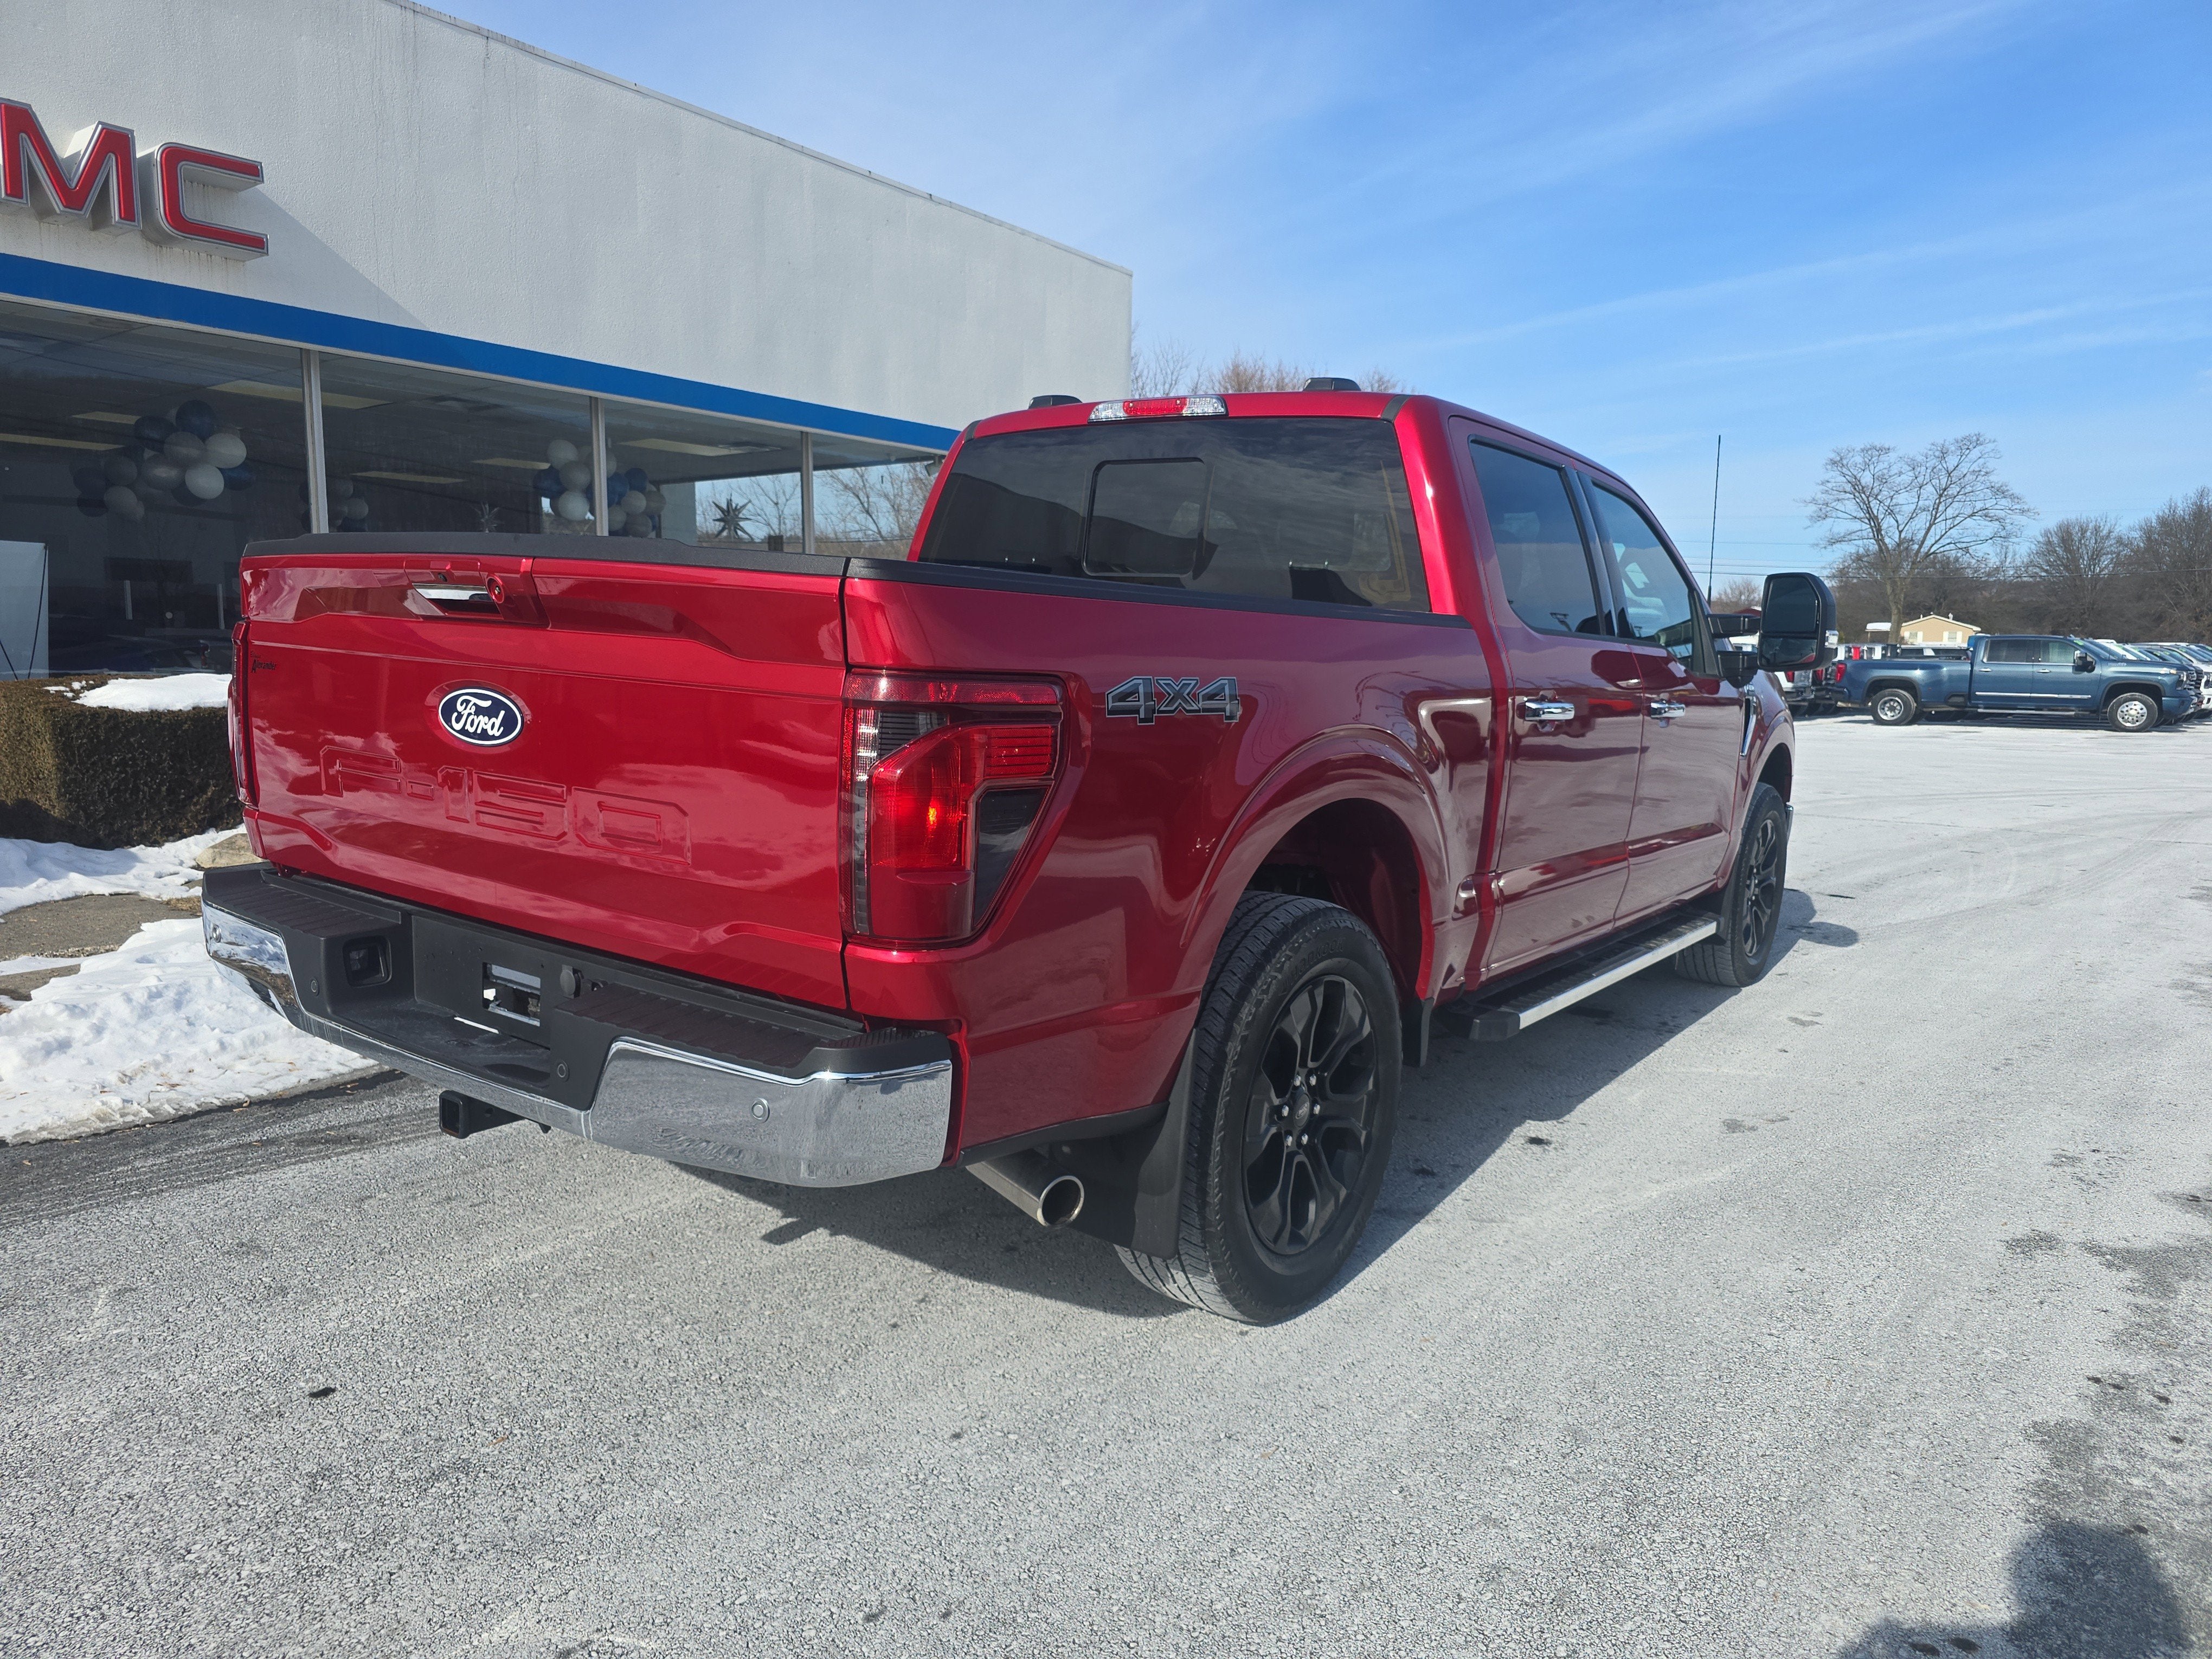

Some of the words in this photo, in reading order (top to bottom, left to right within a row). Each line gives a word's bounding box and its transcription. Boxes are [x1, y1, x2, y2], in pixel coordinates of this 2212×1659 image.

[0, 98, 269, 256] MC
[452, 695, 505, 736] Ford
[319, 745, 692, 866] F-150
